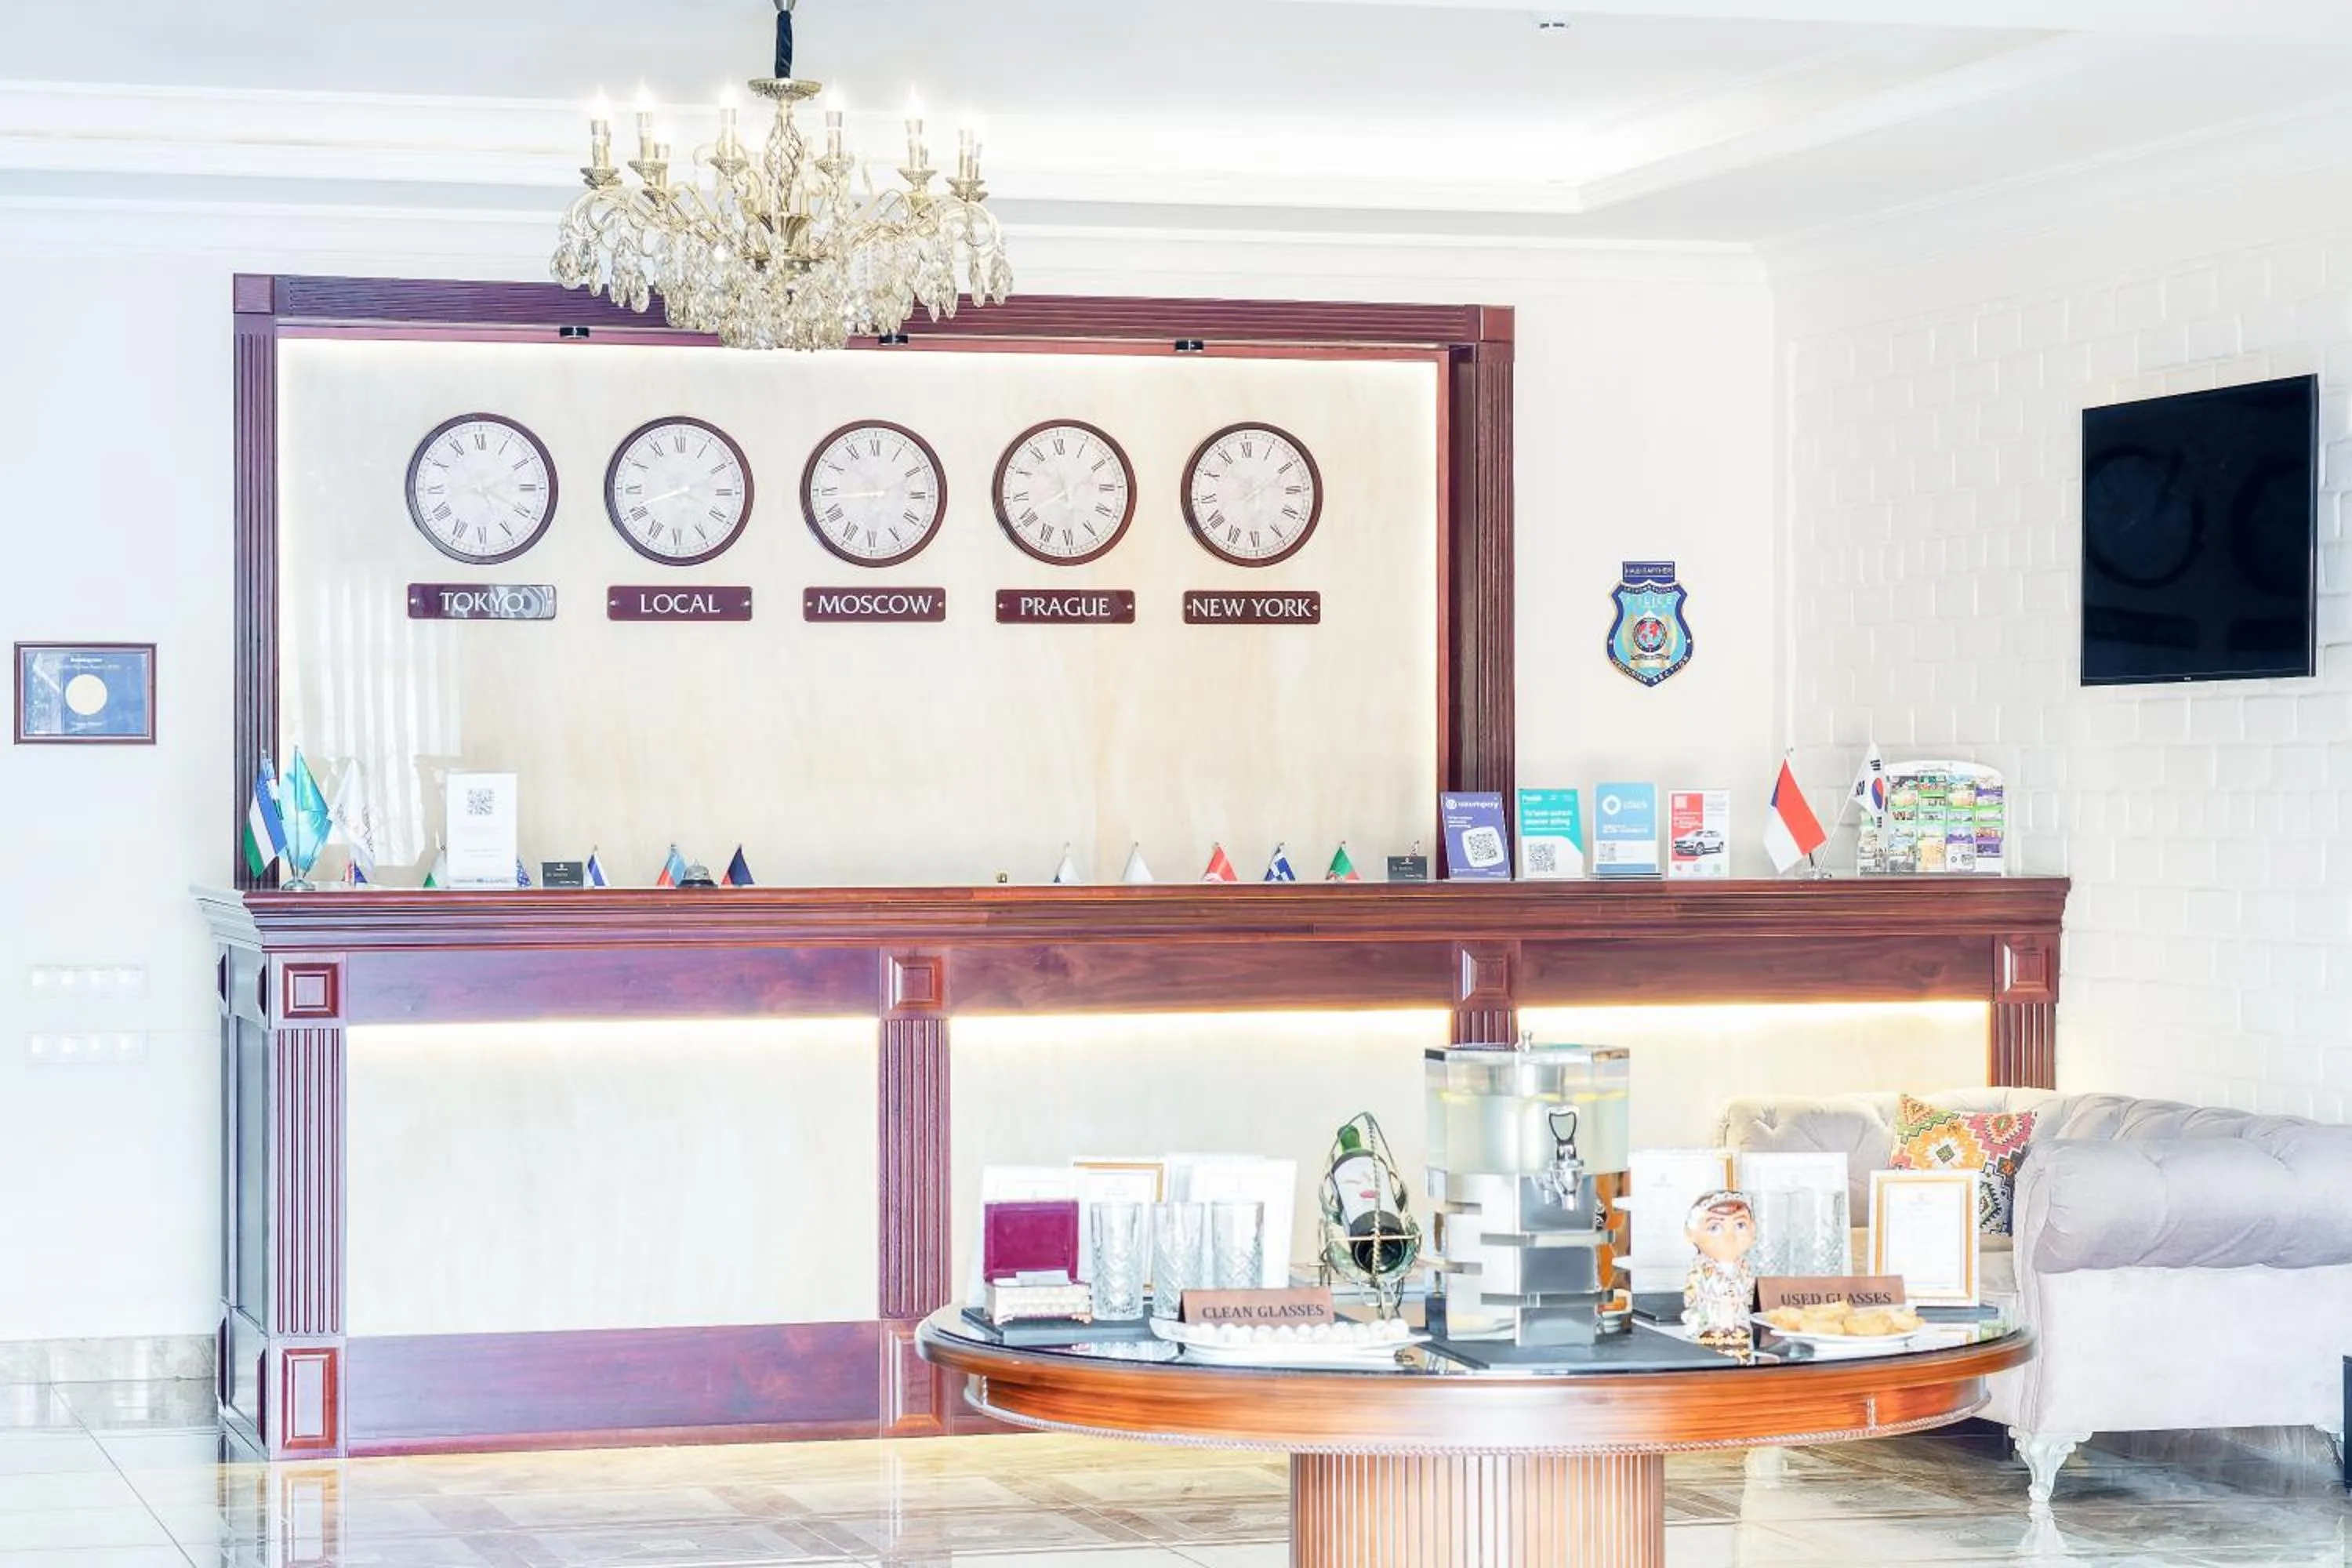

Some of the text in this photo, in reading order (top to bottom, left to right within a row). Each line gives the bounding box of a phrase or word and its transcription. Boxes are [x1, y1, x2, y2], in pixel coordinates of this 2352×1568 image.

[440, 592, 524, 612] TOKYO
[640, 593, 720, 613] LOCAL
[817, 595, 933, 615] MOSCOW
[1020, 597, 1111, 616] PRAGUE
[1192, 598, 1312, 617] NEW YORK
[1780, 1293, 1821, 1305] USED
[1202, 1304, 1325, 1319] CLEAN GLASSES
